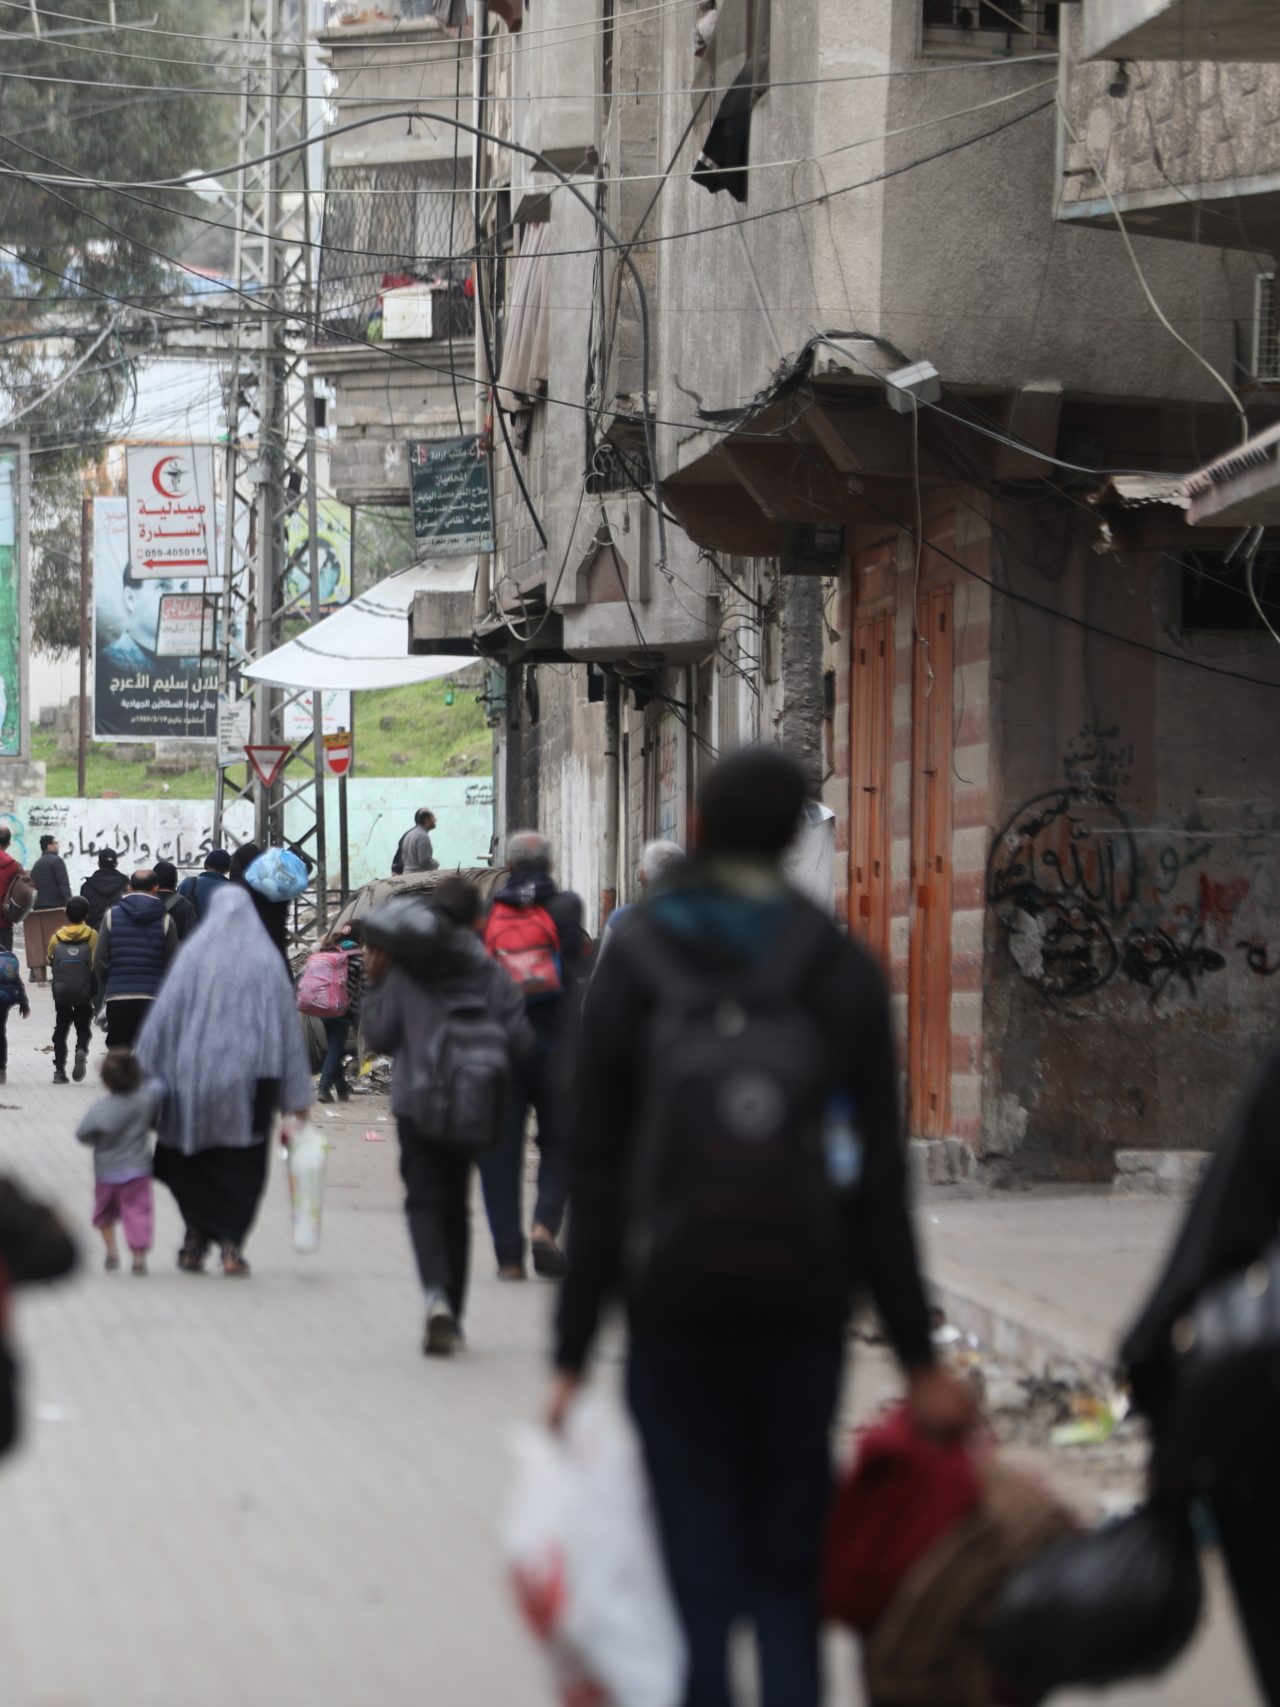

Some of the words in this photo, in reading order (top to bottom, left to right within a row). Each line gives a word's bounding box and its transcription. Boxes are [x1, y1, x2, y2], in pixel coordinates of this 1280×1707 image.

[137, 499, 206, 521] صيدلية
[138, 523, 207, 542] السدرة
[109, 672, 150, 695] الأعرج
[153, 675, 189, 693] سليم
